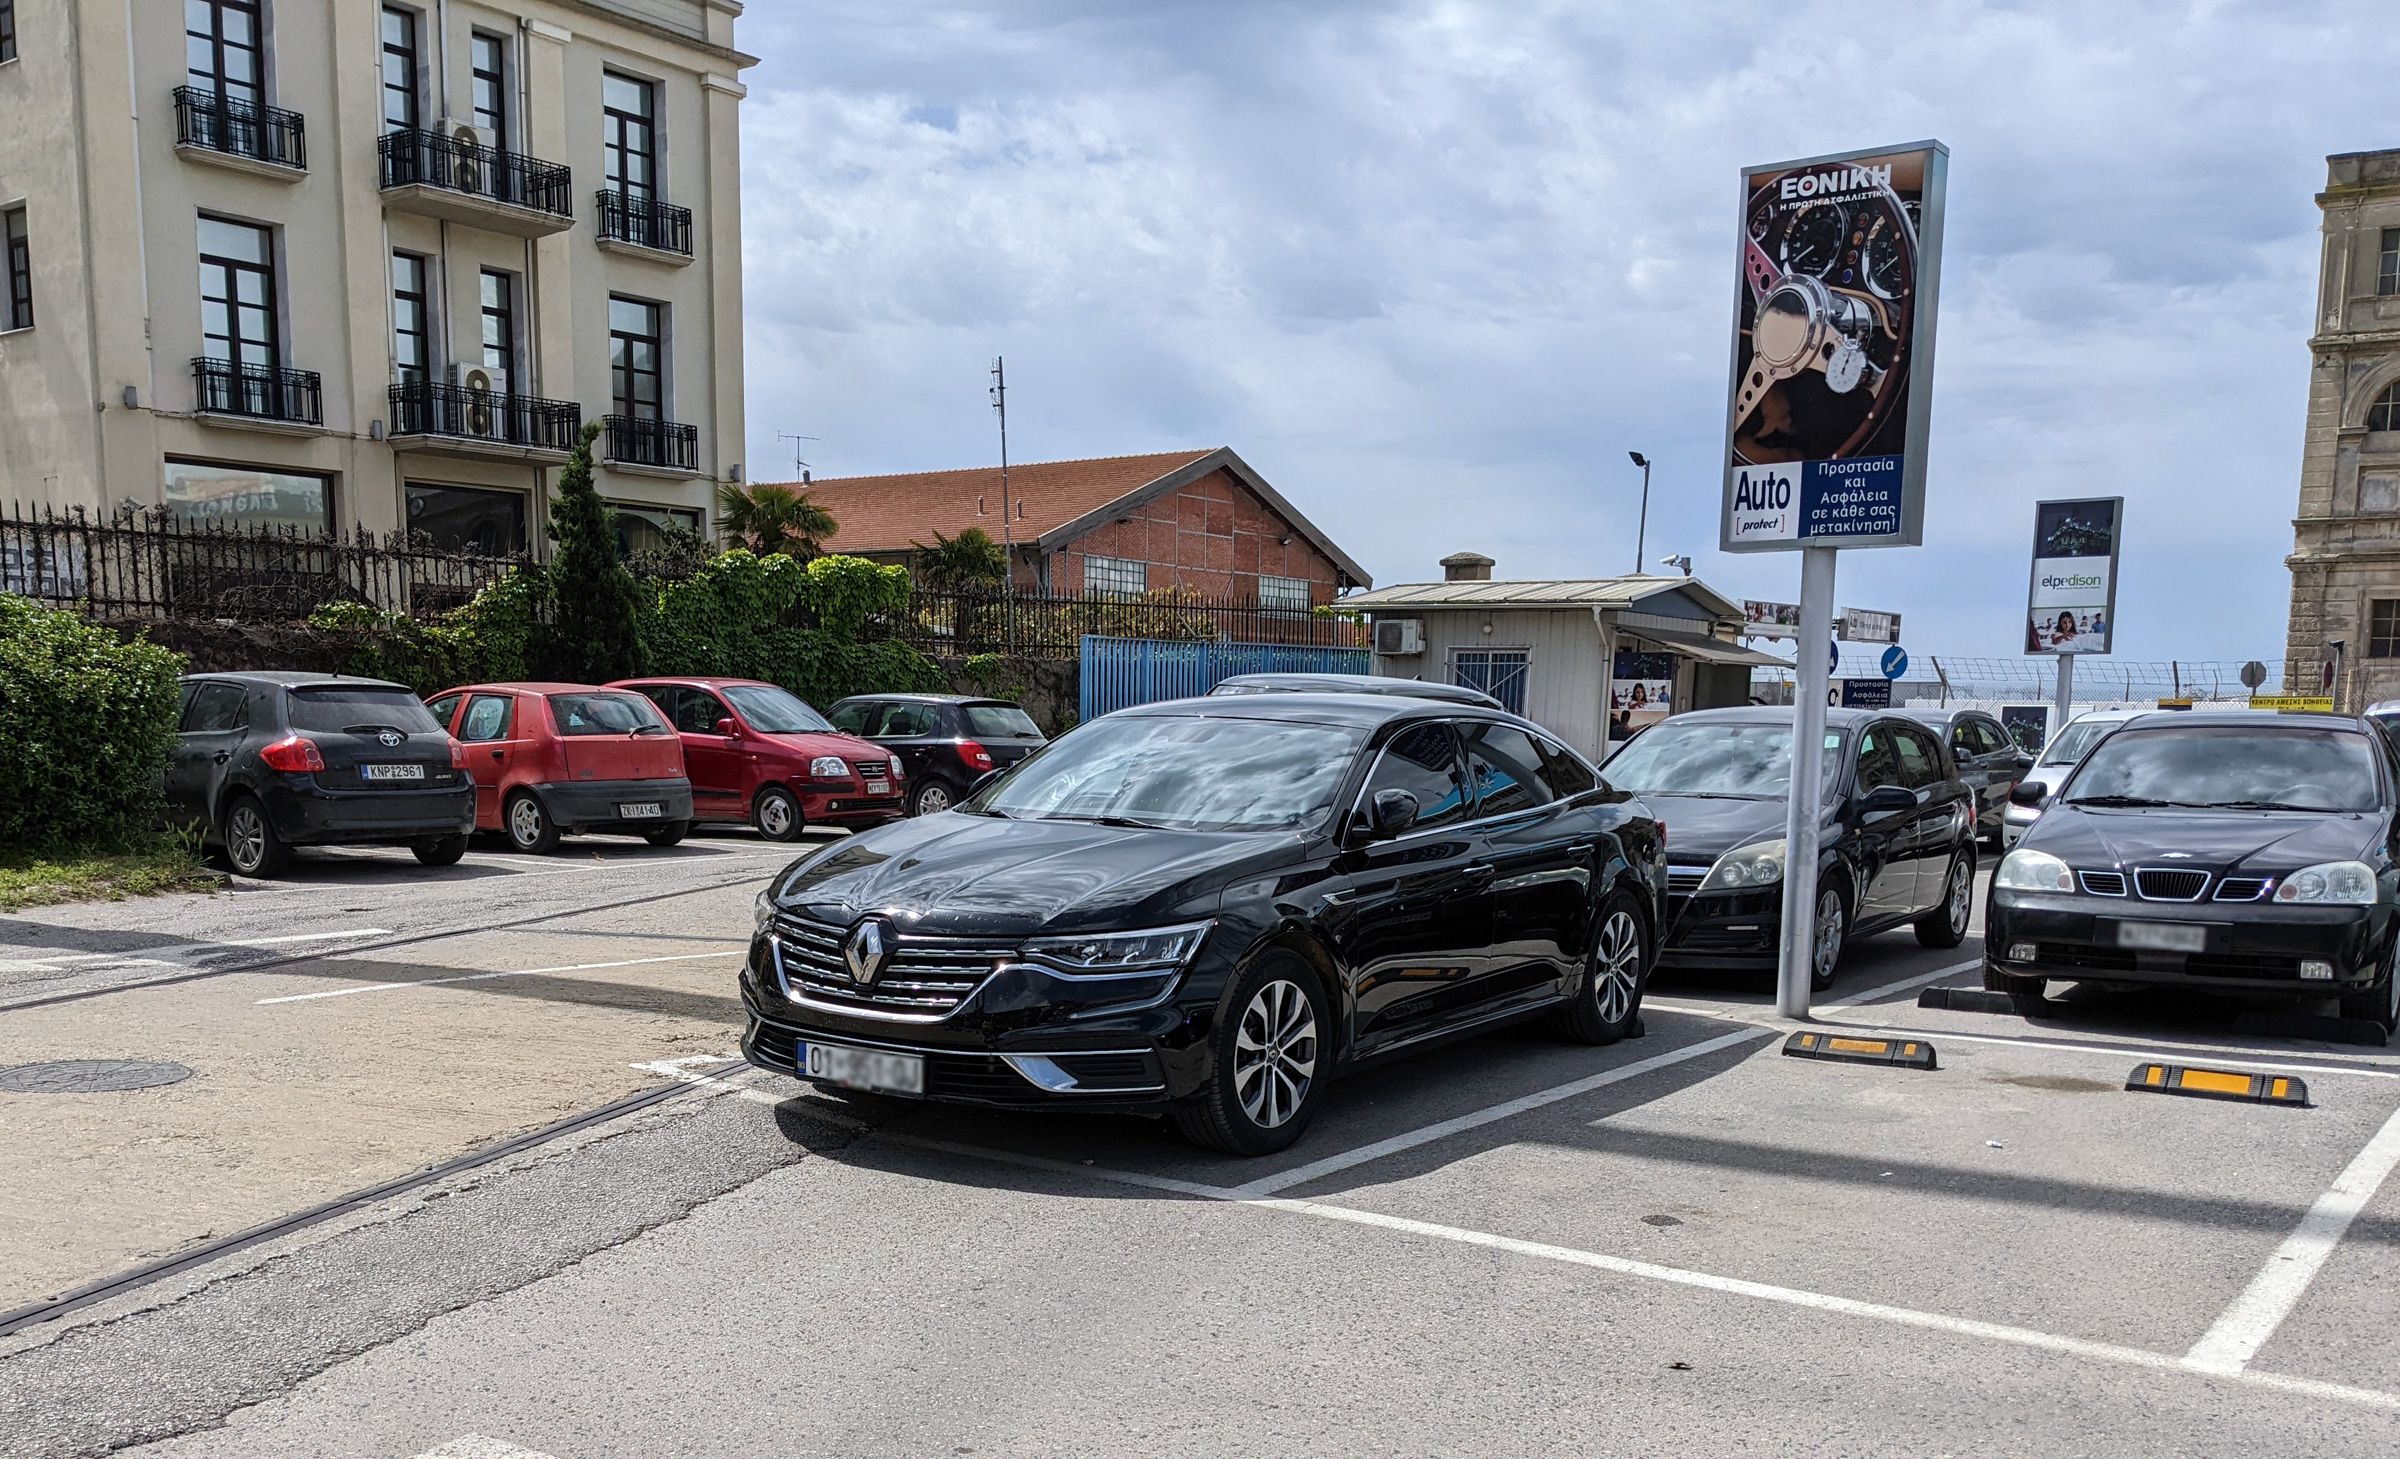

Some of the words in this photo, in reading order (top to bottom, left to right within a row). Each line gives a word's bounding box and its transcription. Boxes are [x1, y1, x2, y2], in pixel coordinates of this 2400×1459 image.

[1779, 204, 1787, 212] Η
[1788, 199, 1821, 211] ΠΡΩΤΗ
[1823, 190, 1890, 206] ΑΣΦΑΛΙΣΤΙΚΗ
[1818, 459, 1895, 478] Προστασία
[1844, 477, 1866, 488] και
[1734, 471, 1791, 512] Auto
[1820, 489, 1888, 507] Ασφάλεια
[1811, 507, 1828, 520] σε
[1832, 504, 1866, 518] κάθε
[1870, 505, 1896, 519] σας
[1810, 517, 1896, 537] μετακίνηση!
[1849, 681, 1889, 689] Προστασία
[1852, 691, 1888, 699] Ασφάλεια
[2251, 698, 2275, 706] ΚΕΝΤΡΟ
[2276, 698, 2301, 706] ΑΜΕΣΗΣ
[2302, 698, 2333, 706] ΒΟΗΘΕΙΑΣ
